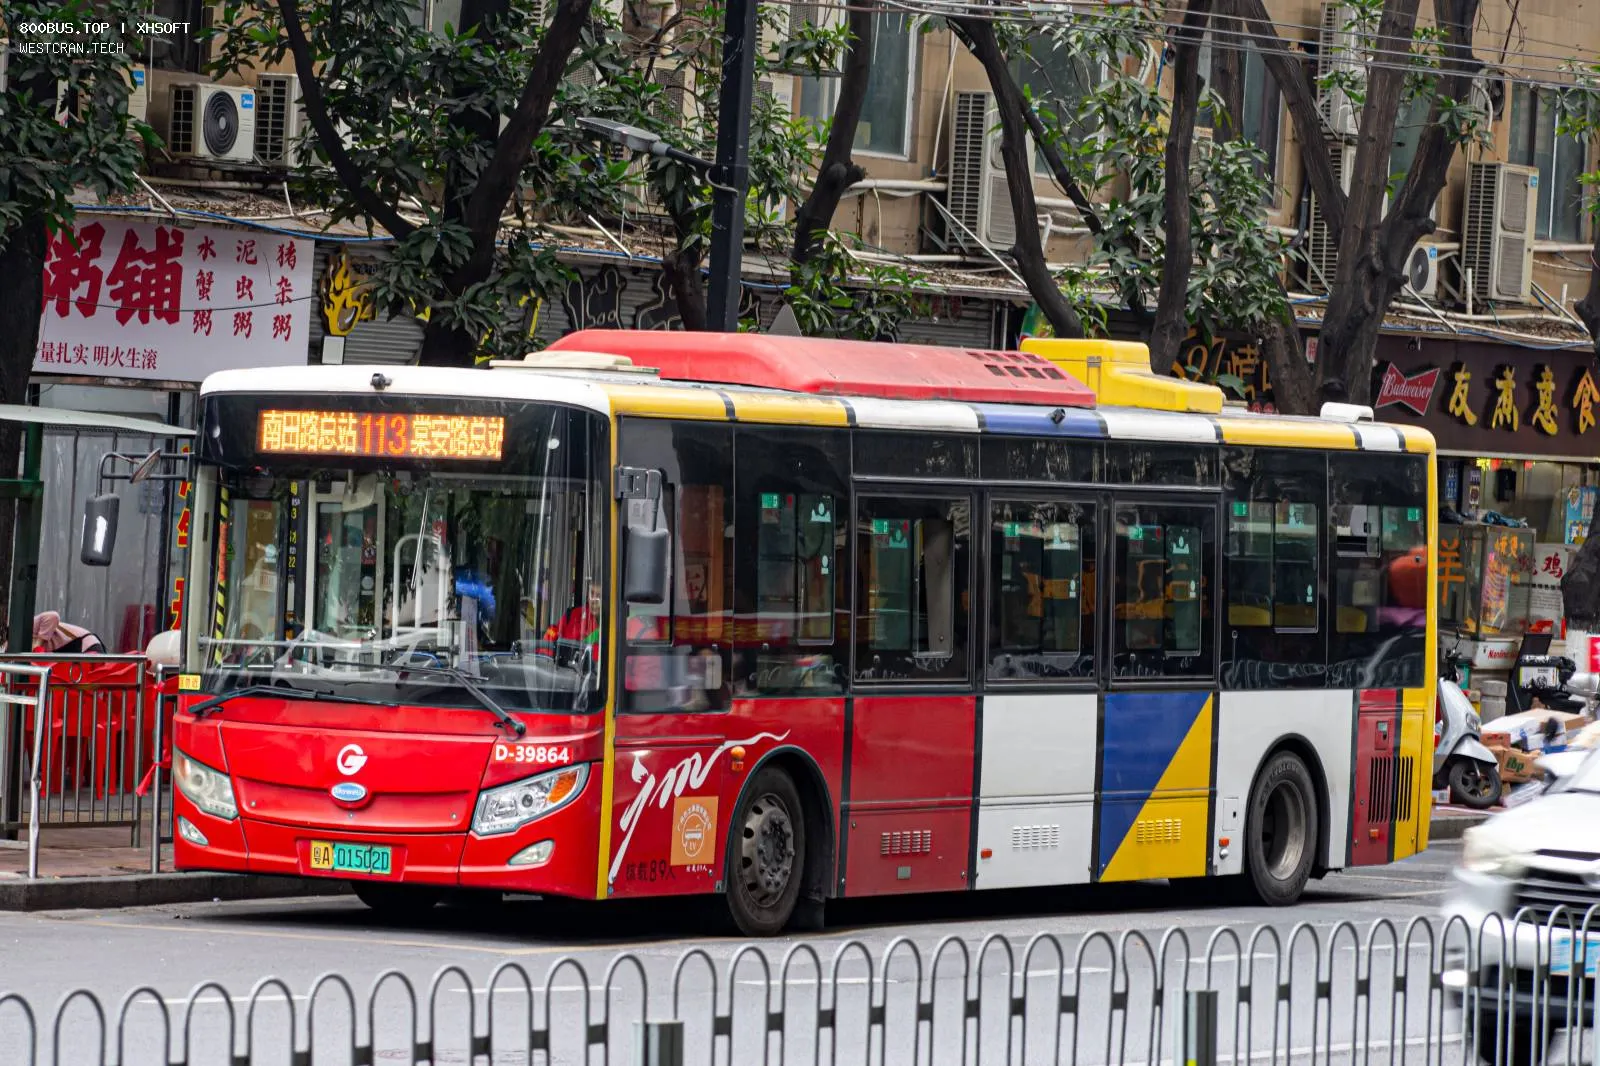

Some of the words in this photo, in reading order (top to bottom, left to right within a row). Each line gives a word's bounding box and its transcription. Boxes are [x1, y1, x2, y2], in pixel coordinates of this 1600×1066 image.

[193, 236, 216, 337] 水蟹粥
[233, 239, 258, 340] 泥虫粥
[272, 240, 297, 342] 猪杂粥
[1382, 374, 1432, 398] Budweiser
[262, 410, 358, 453] 南田路总站
[362, 415, 407, 455] 113
[411, 414, 504, 458] 棠安路总站
[494, 744, 570, 763] D-39864
